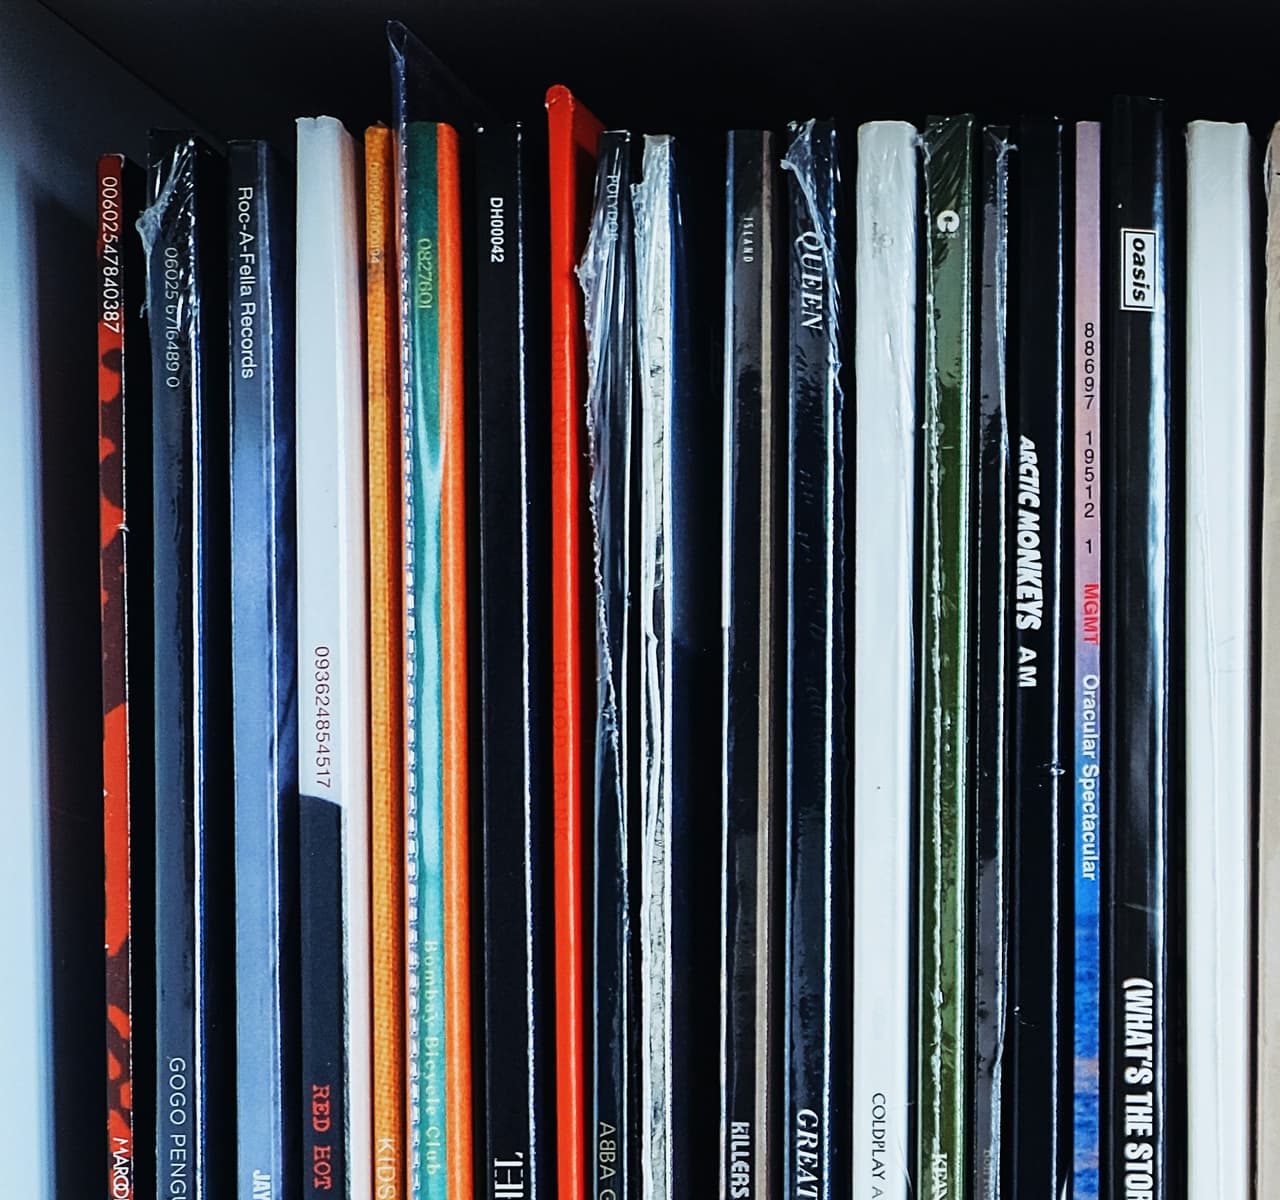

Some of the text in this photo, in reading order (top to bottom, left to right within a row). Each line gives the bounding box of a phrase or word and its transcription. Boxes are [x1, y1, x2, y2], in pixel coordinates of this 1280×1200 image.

[103, 177, 118, 333] 00602547840387
[490, 197, 504, 262] DH00042
[239, 187, 256, 378] Roc-A-Fella Records
[797, 229, 826, 332] QUEEN
[1133, 238, 1150, 301] oasis
[1016, 435, 1043, 687] ARCTIC MONKEYS AM
[315, 647, 330, 788] 093624854517
[1080, 583, 1099, 880] MGMT Oracular Spectacular
[170, 1057, 186, 1124] GOGO
[313, 1085, 330, 1131] RED
[314, 1146, 331, 1189] HOT
[377, 1138, 395, 1200] KIDS
[872, 1093, 886, 1180] COLDPLAY
[872, 1186, 883, 1199] A
